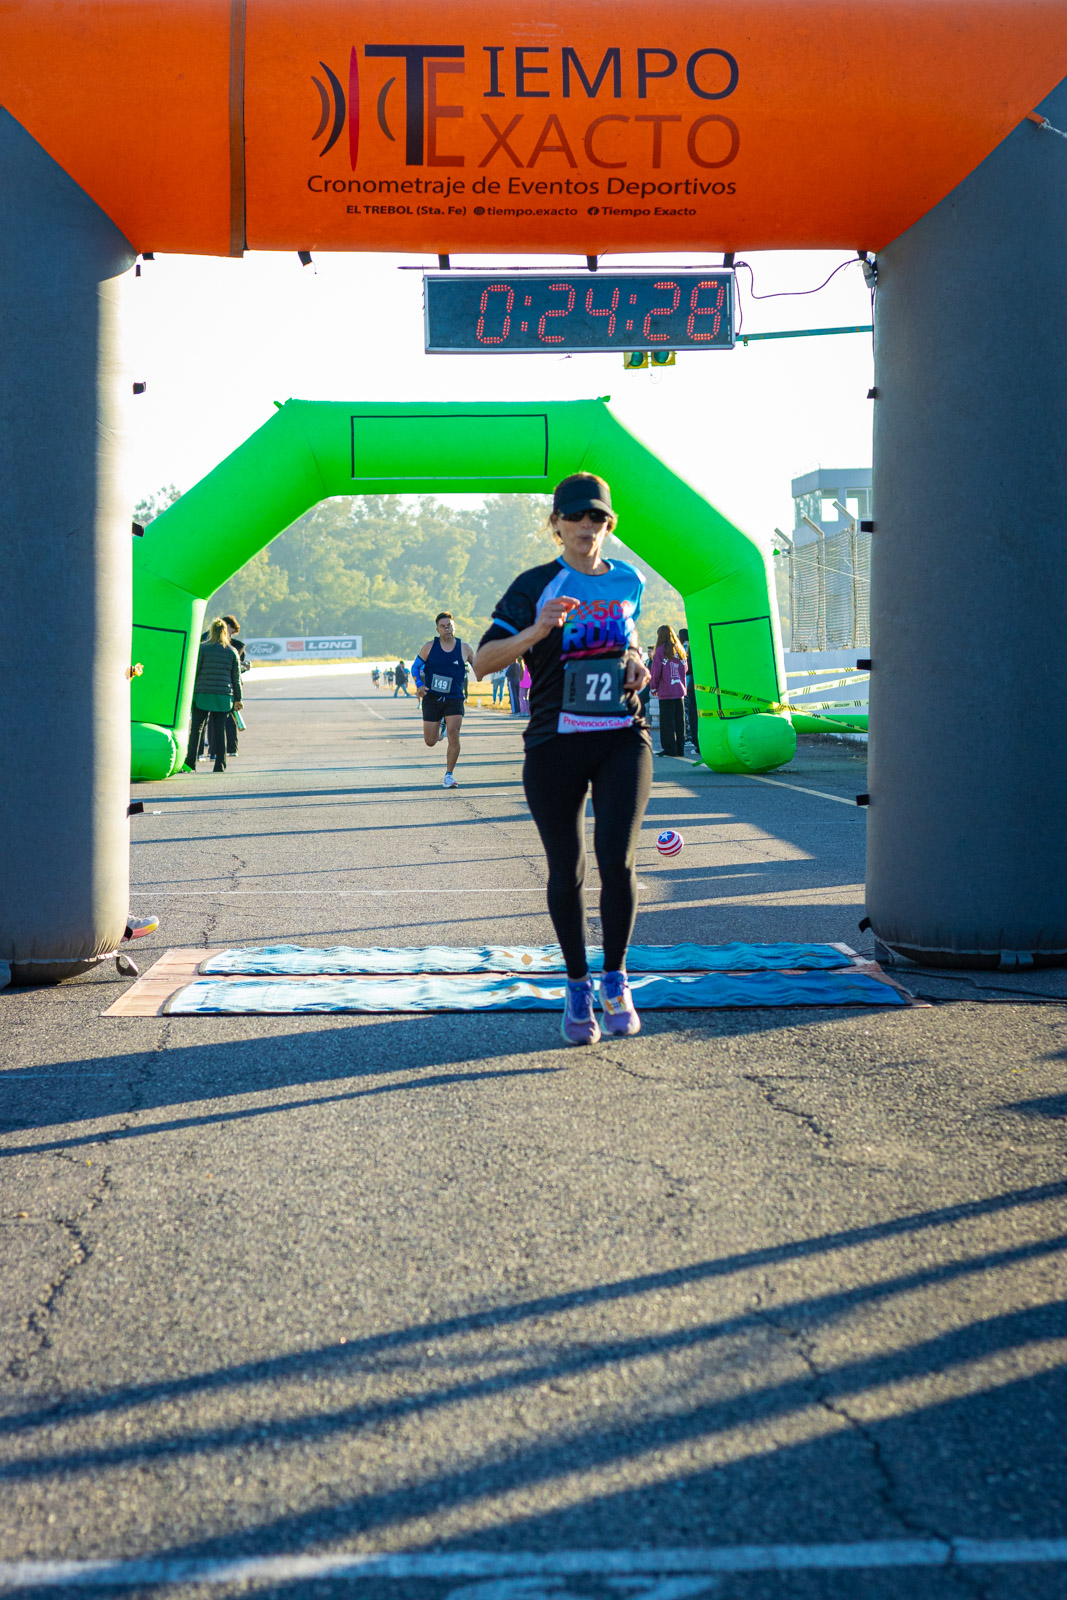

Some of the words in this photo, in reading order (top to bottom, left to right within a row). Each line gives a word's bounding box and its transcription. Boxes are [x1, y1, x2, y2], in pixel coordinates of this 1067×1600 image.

[307, 175, 465, 197] Cronometraje
[472, 176, 500, 194] de
[508, 177, 599, 195] Eventos
[607, 177, 737, 199] Deportivos
[346, 205, 361, 214] EL
[363, 205, 413, 215] TREBOL
[416, 205, 445, 216] (Sta.
[448, 206, 467, 216] Fe)
[487, 206, 578, 217] tiempo.exacto
[602, 206, 650, 217] Tiempo
[654, 207, 697, 216] Exacto
[476, 281, 725, 344] 0:24:28
[250, 644, 274, 653] Ford
[308, 641, 353, 650] LONG
[562, 621, 627, 651] RUN
[433, 678, 448, 690] 149
[586, 672, 612, 701] 72
